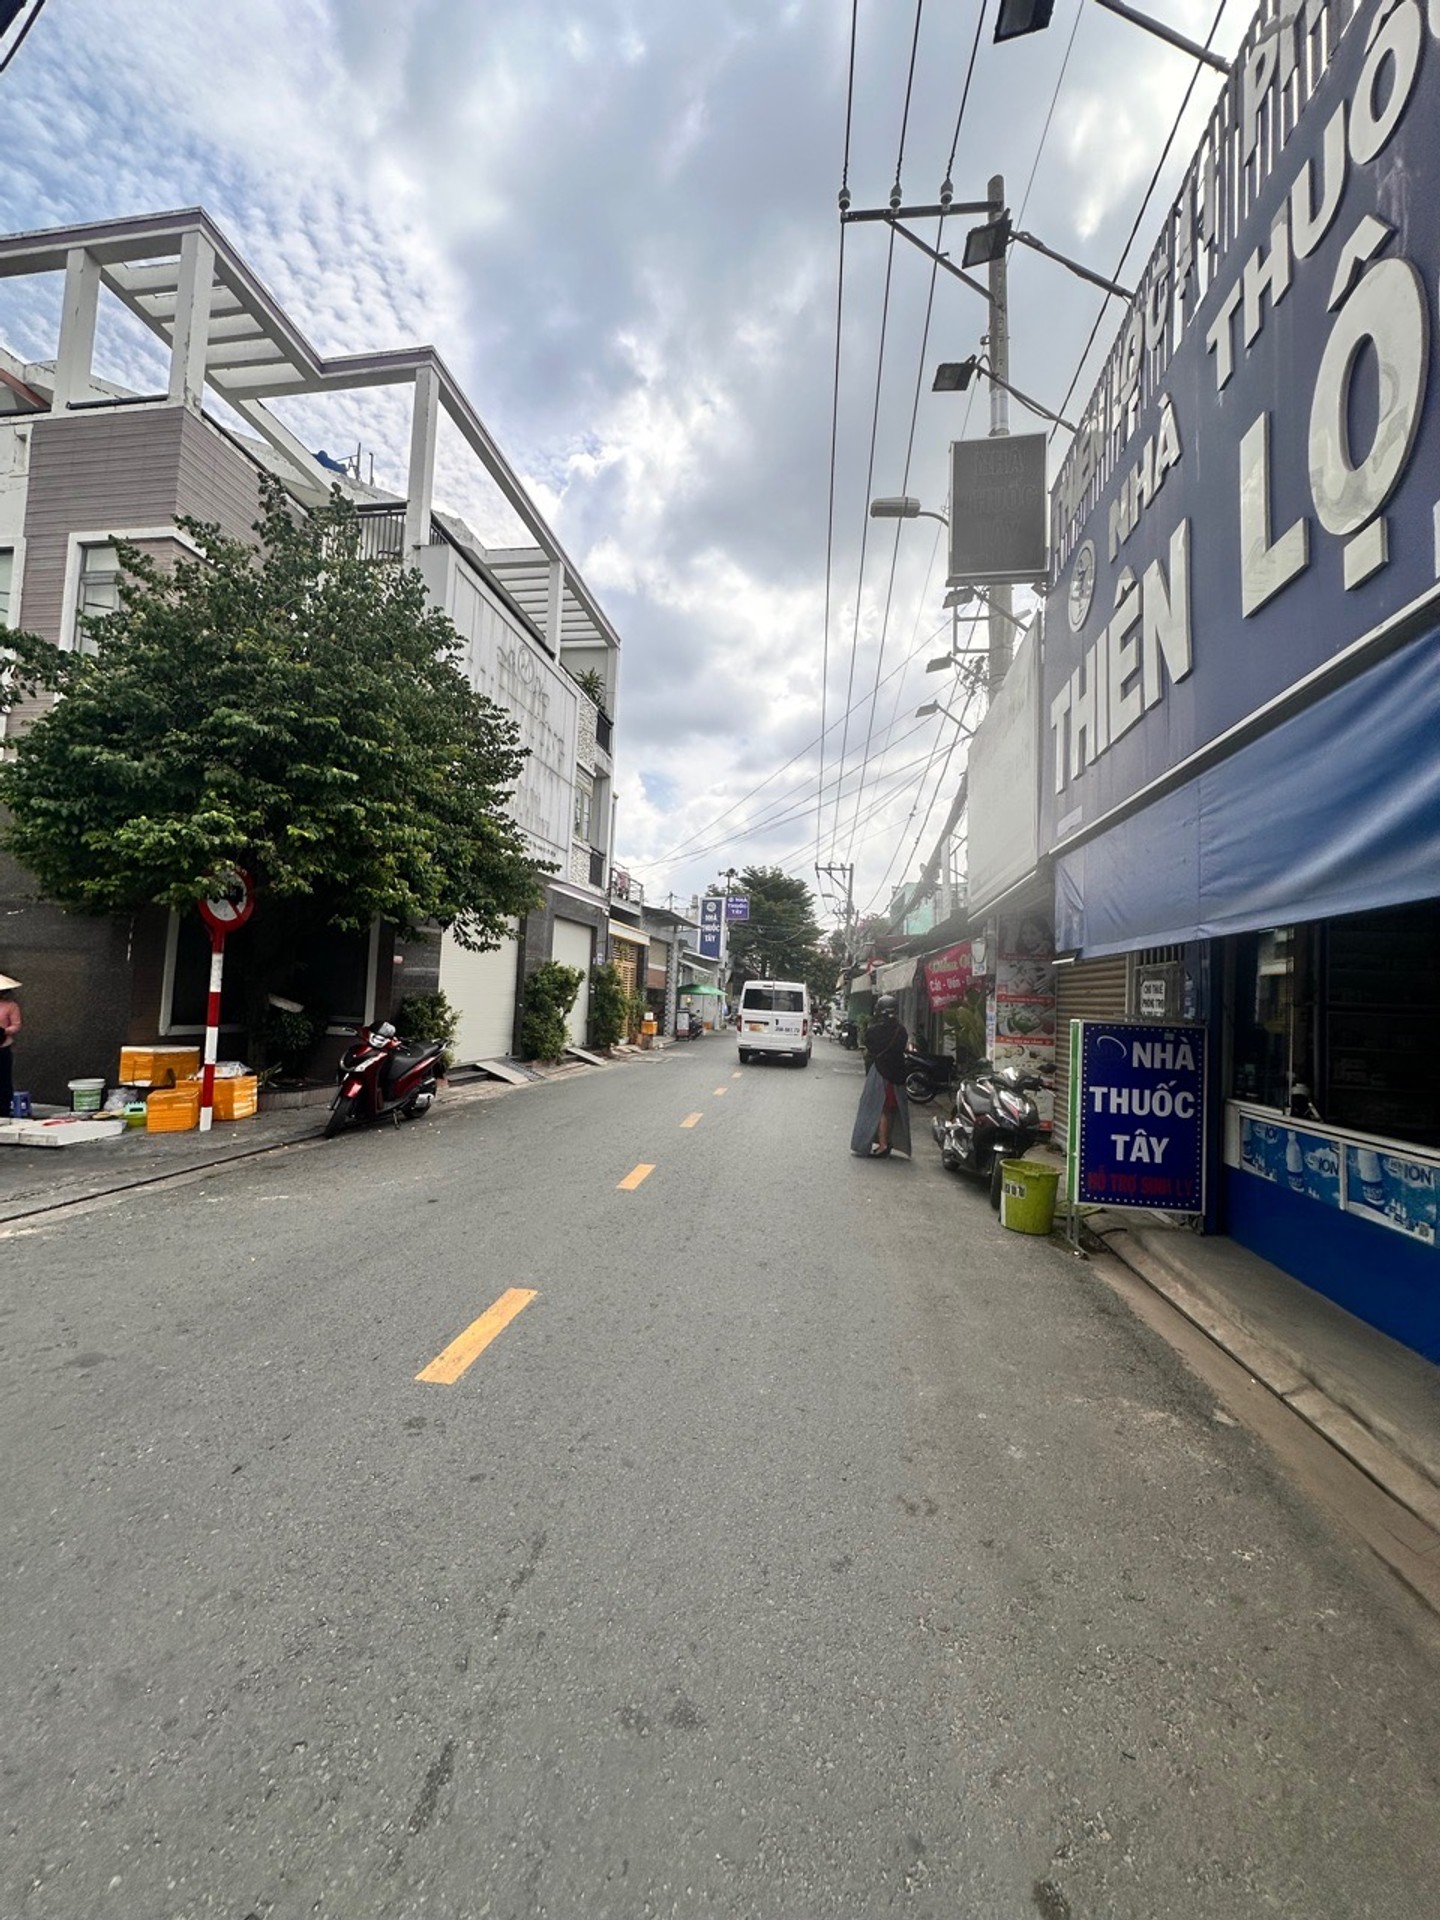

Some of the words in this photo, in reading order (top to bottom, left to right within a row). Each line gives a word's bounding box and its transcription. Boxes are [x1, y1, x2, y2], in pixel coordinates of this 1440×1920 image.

[1108, 392, 1182, 563] NHÀ
[1051, 516, 1193, 795] THIÊN
[1239, 214, 1440, 618] LỘ
[1132, 1036, 1195, 1071] NHÀ
[1088, 1080, 1195, 1119] THUỐC
[1110, 1128, 1170, 1164] TÂY
